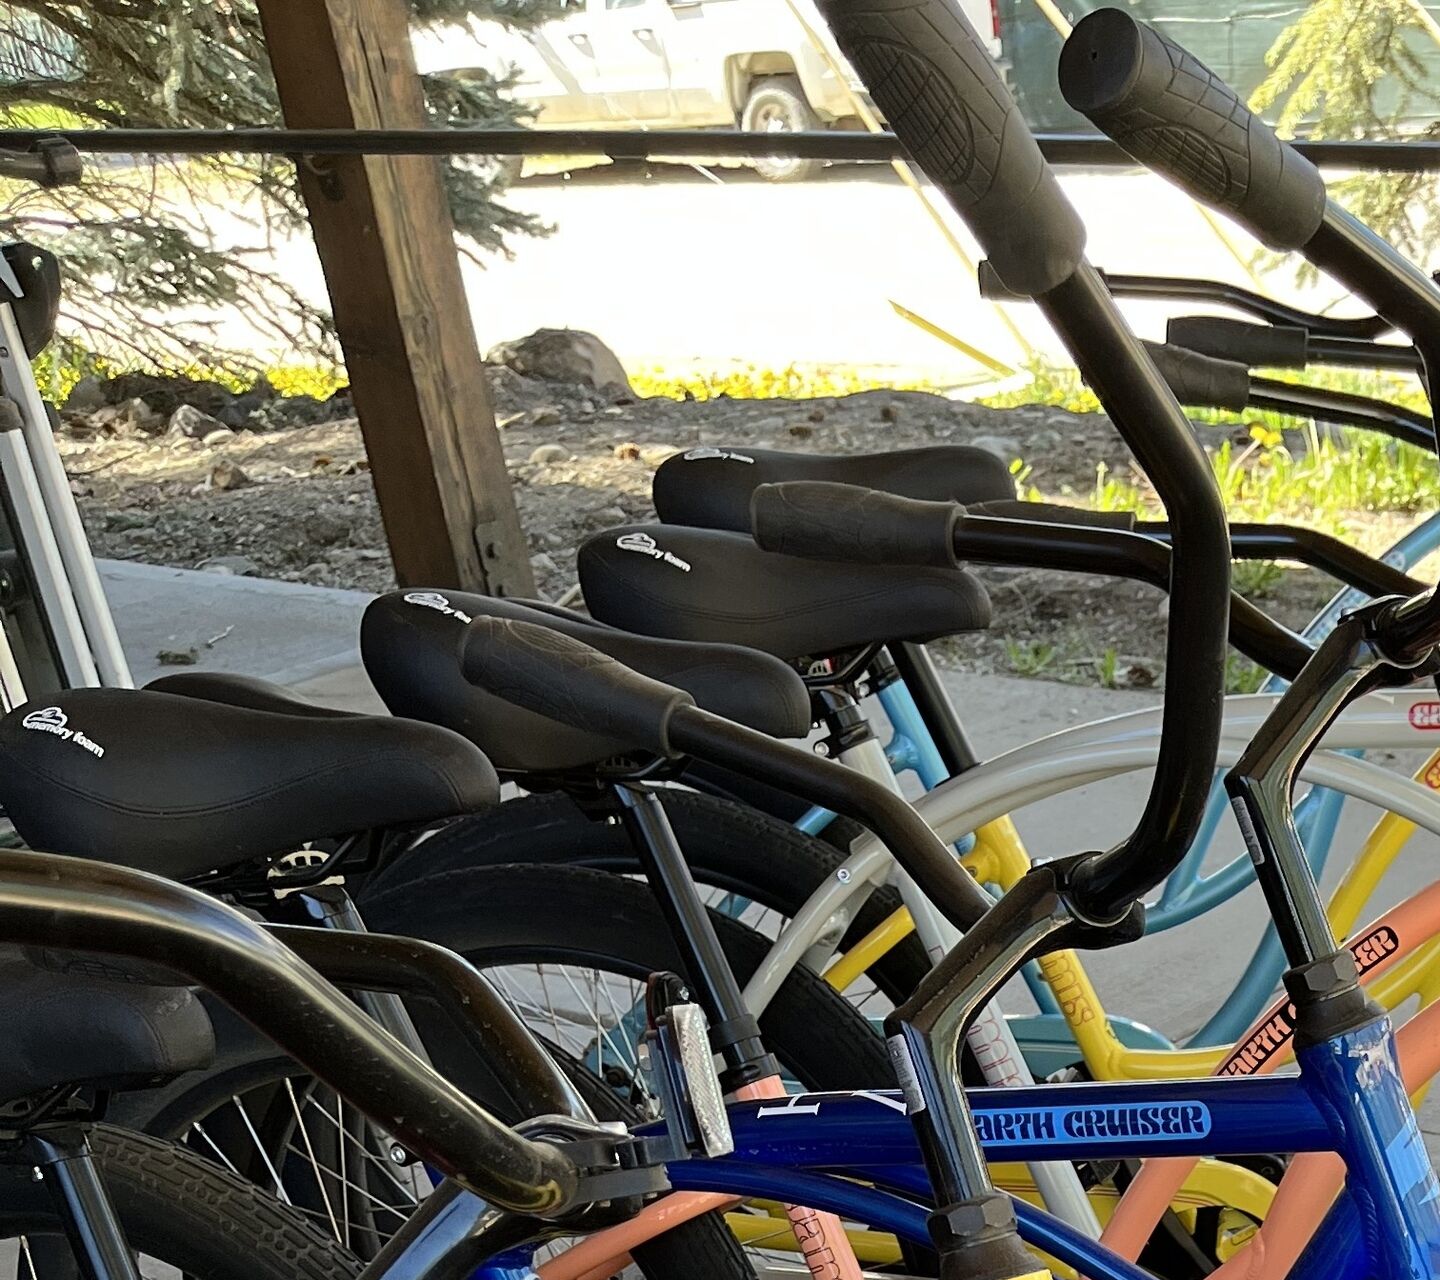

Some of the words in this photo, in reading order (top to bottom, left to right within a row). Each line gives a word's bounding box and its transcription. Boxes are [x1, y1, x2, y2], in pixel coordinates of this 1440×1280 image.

[73, 731, 104, 758] foam
[1220, 1014, 1292, 1077] ARTH
[974, 1112, 1056, 1140] ARTH
[1063, 1106, 1205, 1139] CRUISER
